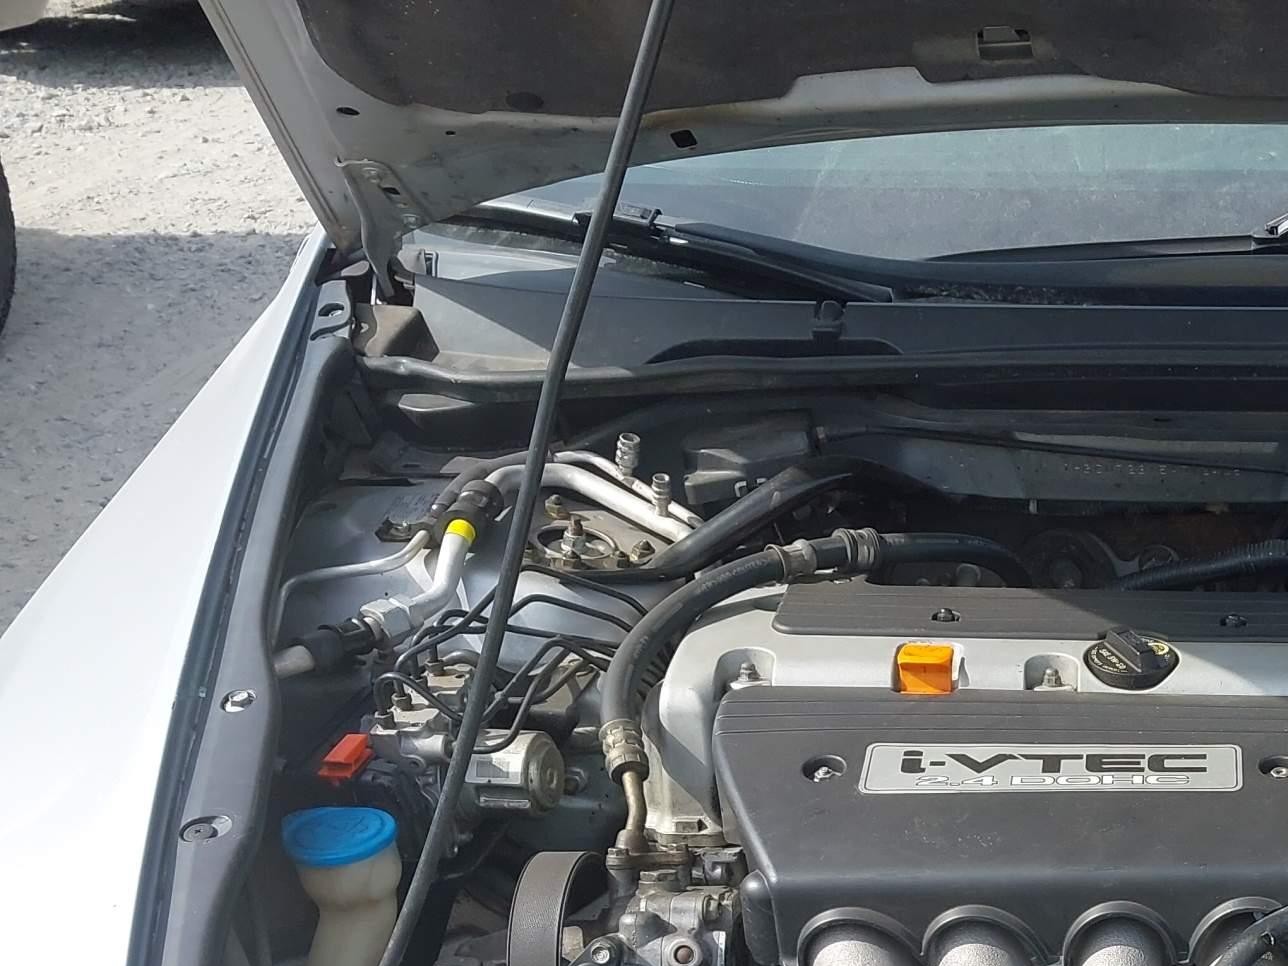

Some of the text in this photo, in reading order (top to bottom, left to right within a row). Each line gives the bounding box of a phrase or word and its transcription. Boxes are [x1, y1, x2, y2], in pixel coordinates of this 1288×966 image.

[900, 750, 1208, 774] i-VTEC
[915, 774, 1190, 787] 2.4 DOHC
